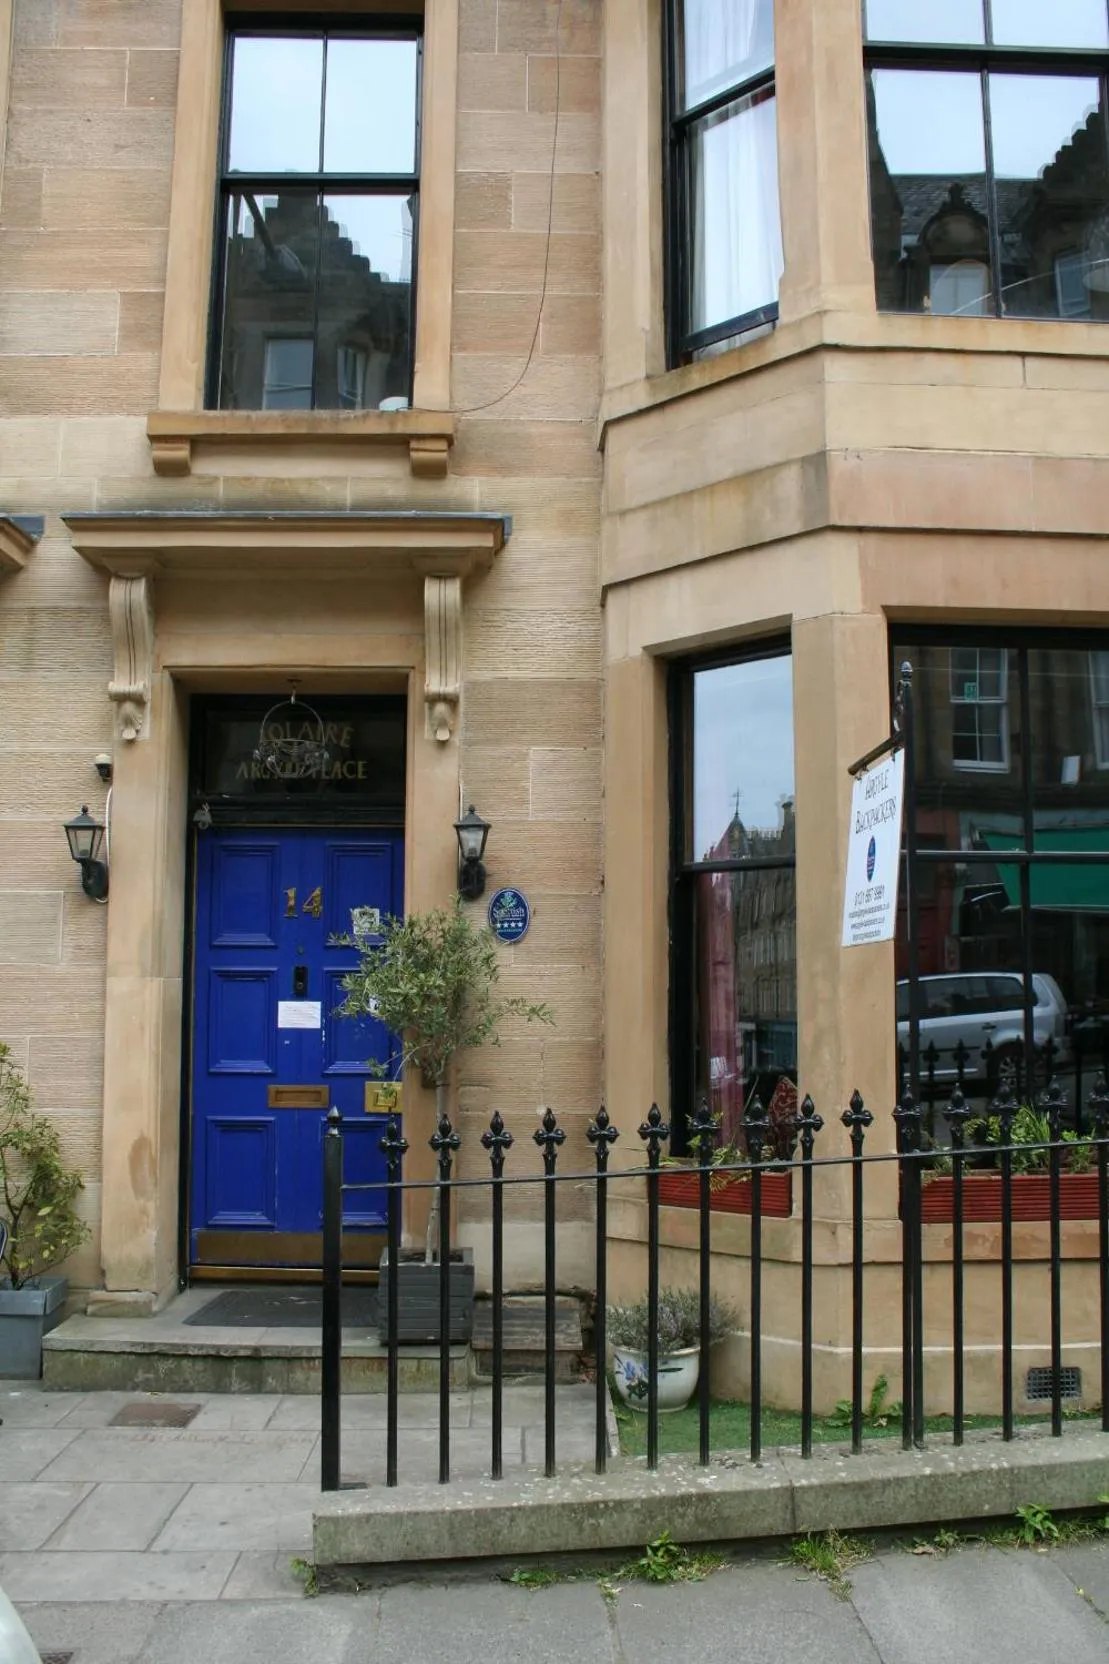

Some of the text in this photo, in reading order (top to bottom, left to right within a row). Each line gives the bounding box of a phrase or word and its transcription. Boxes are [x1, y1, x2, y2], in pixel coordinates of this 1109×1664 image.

[257, 720, 355, 748] OLAIRE
[311, 760, 368, 780] PLACE
[855, 796, 897, 835] BACKPACKERS
[283, 886, 323, 919] 14
